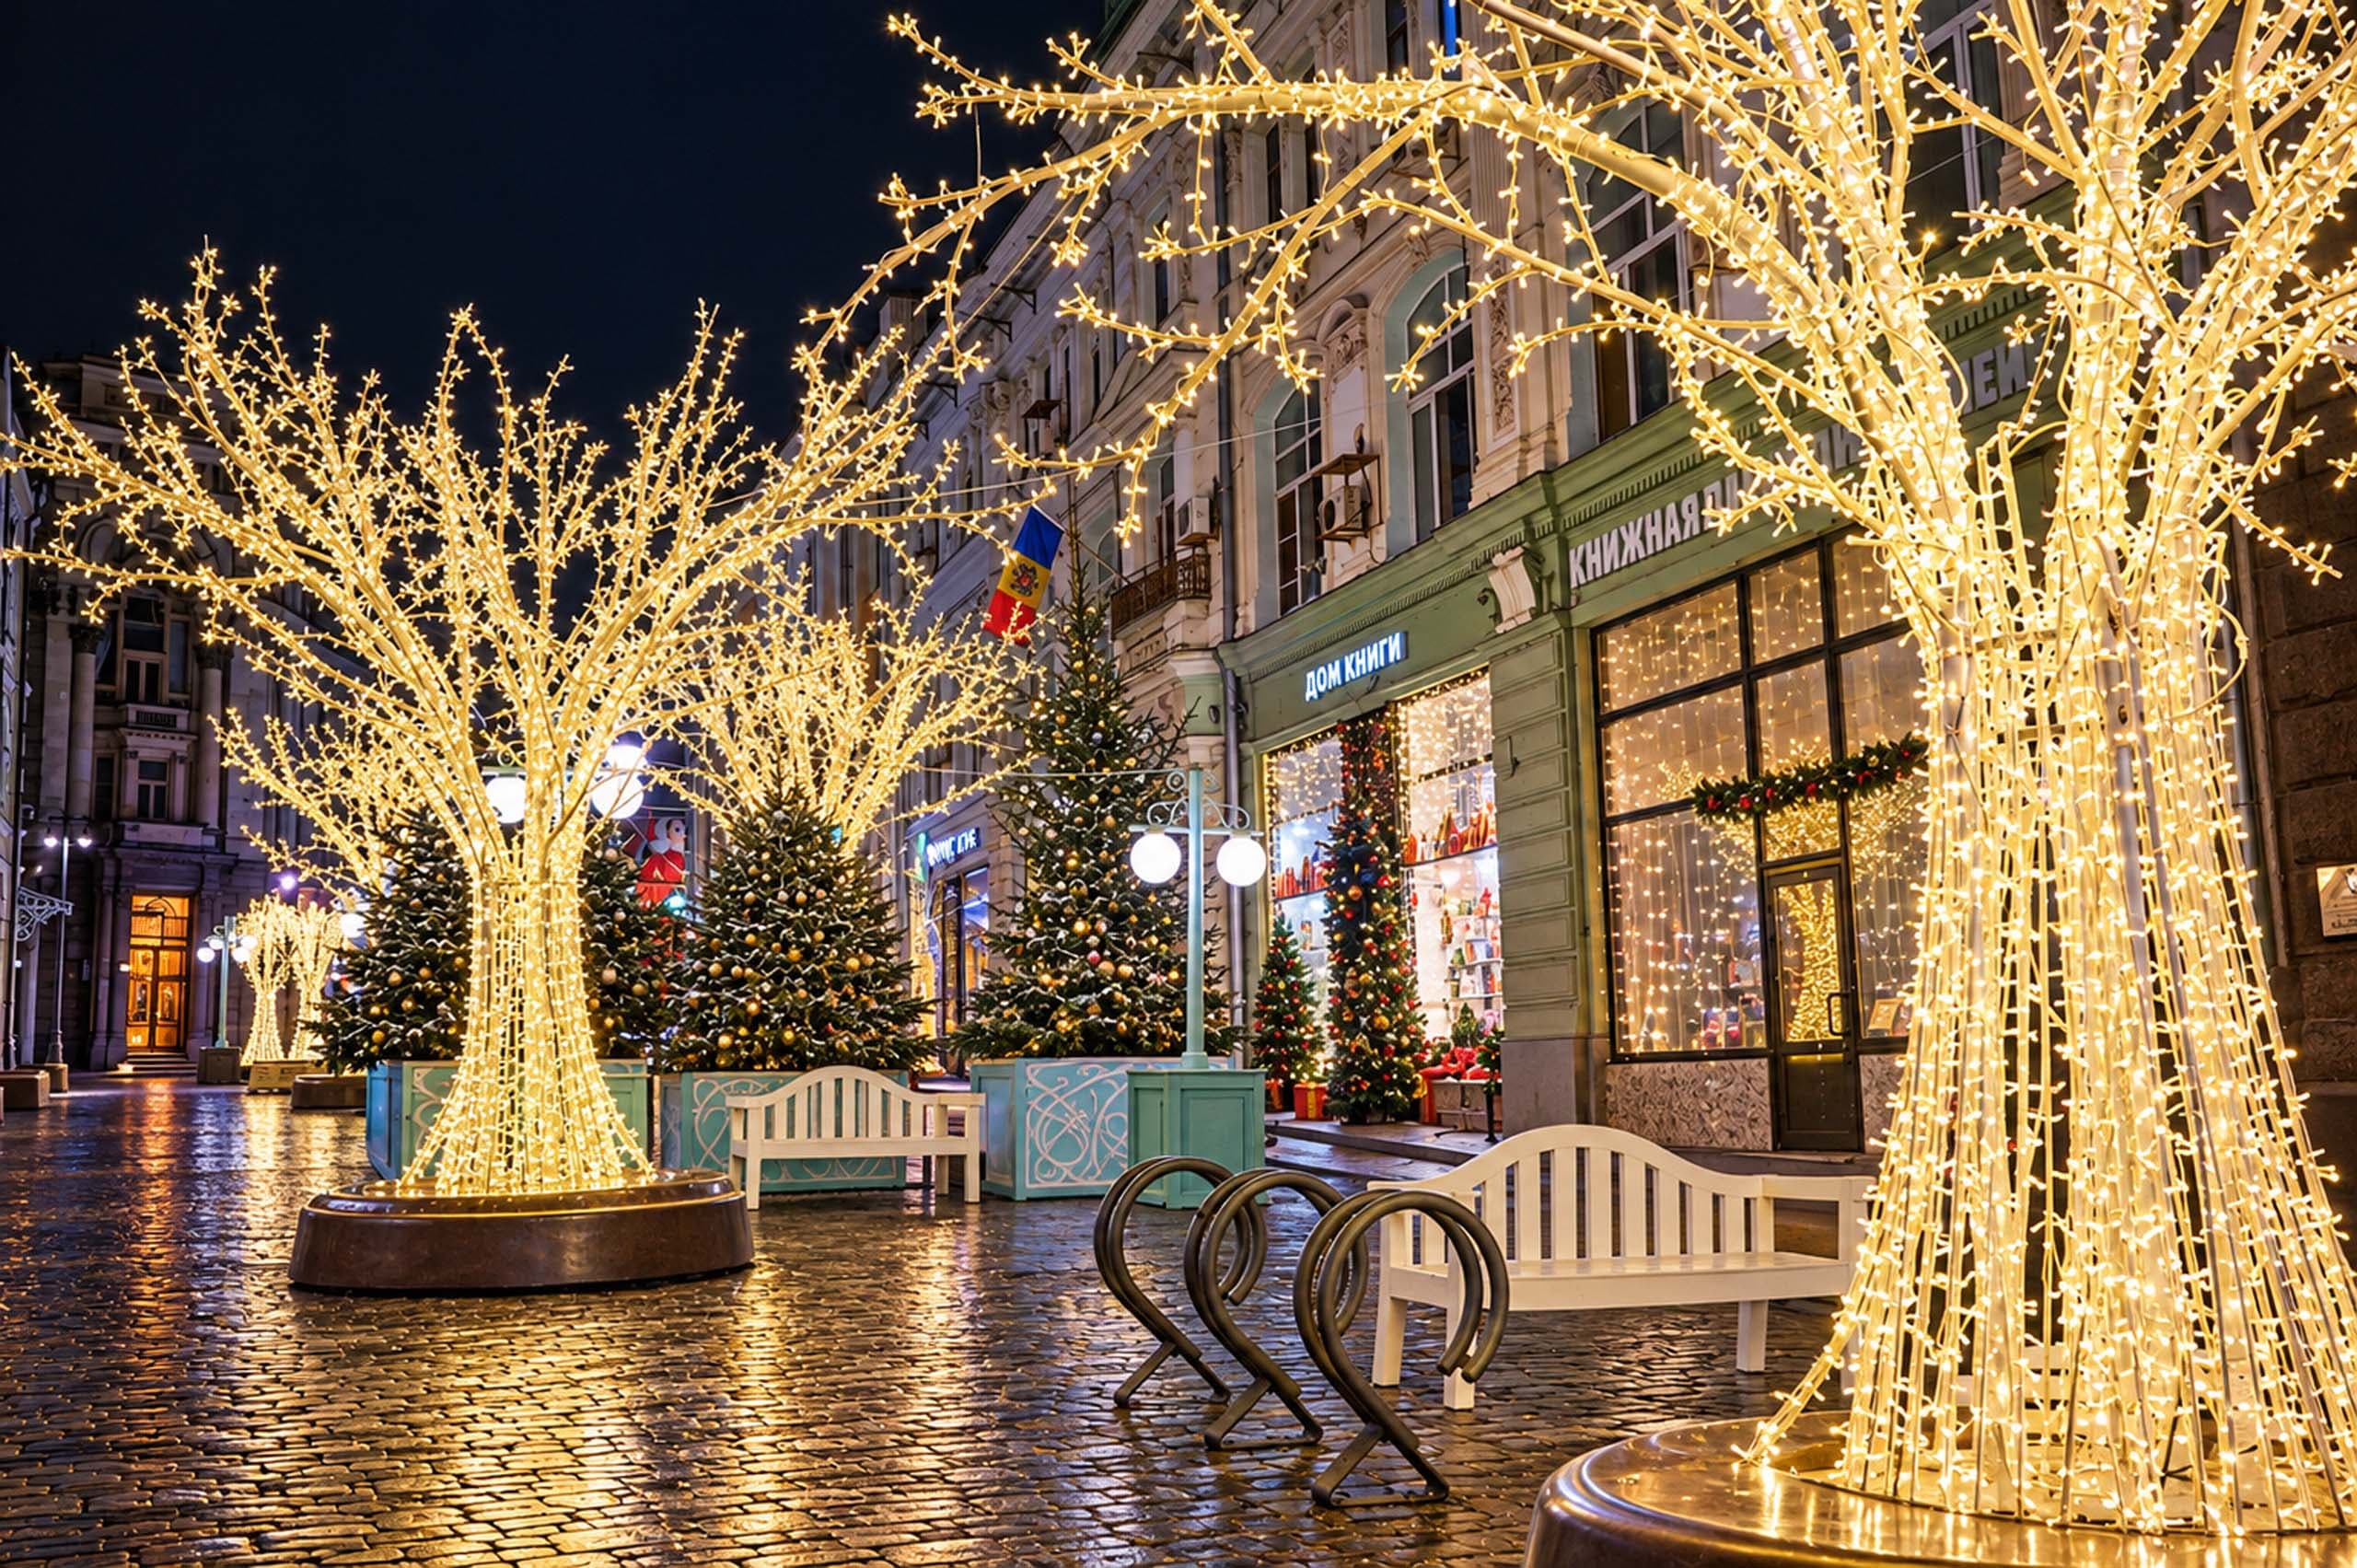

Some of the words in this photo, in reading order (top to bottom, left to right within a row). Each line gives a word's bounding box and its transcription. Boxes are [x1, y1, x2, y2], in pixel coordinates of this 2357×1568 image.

[1569, 493, 1701, 589] КНИЖНАЯ
[1306, 659, 1341, 703] ДОМ
[1344, 632, 1402, 683] КНИГИ
